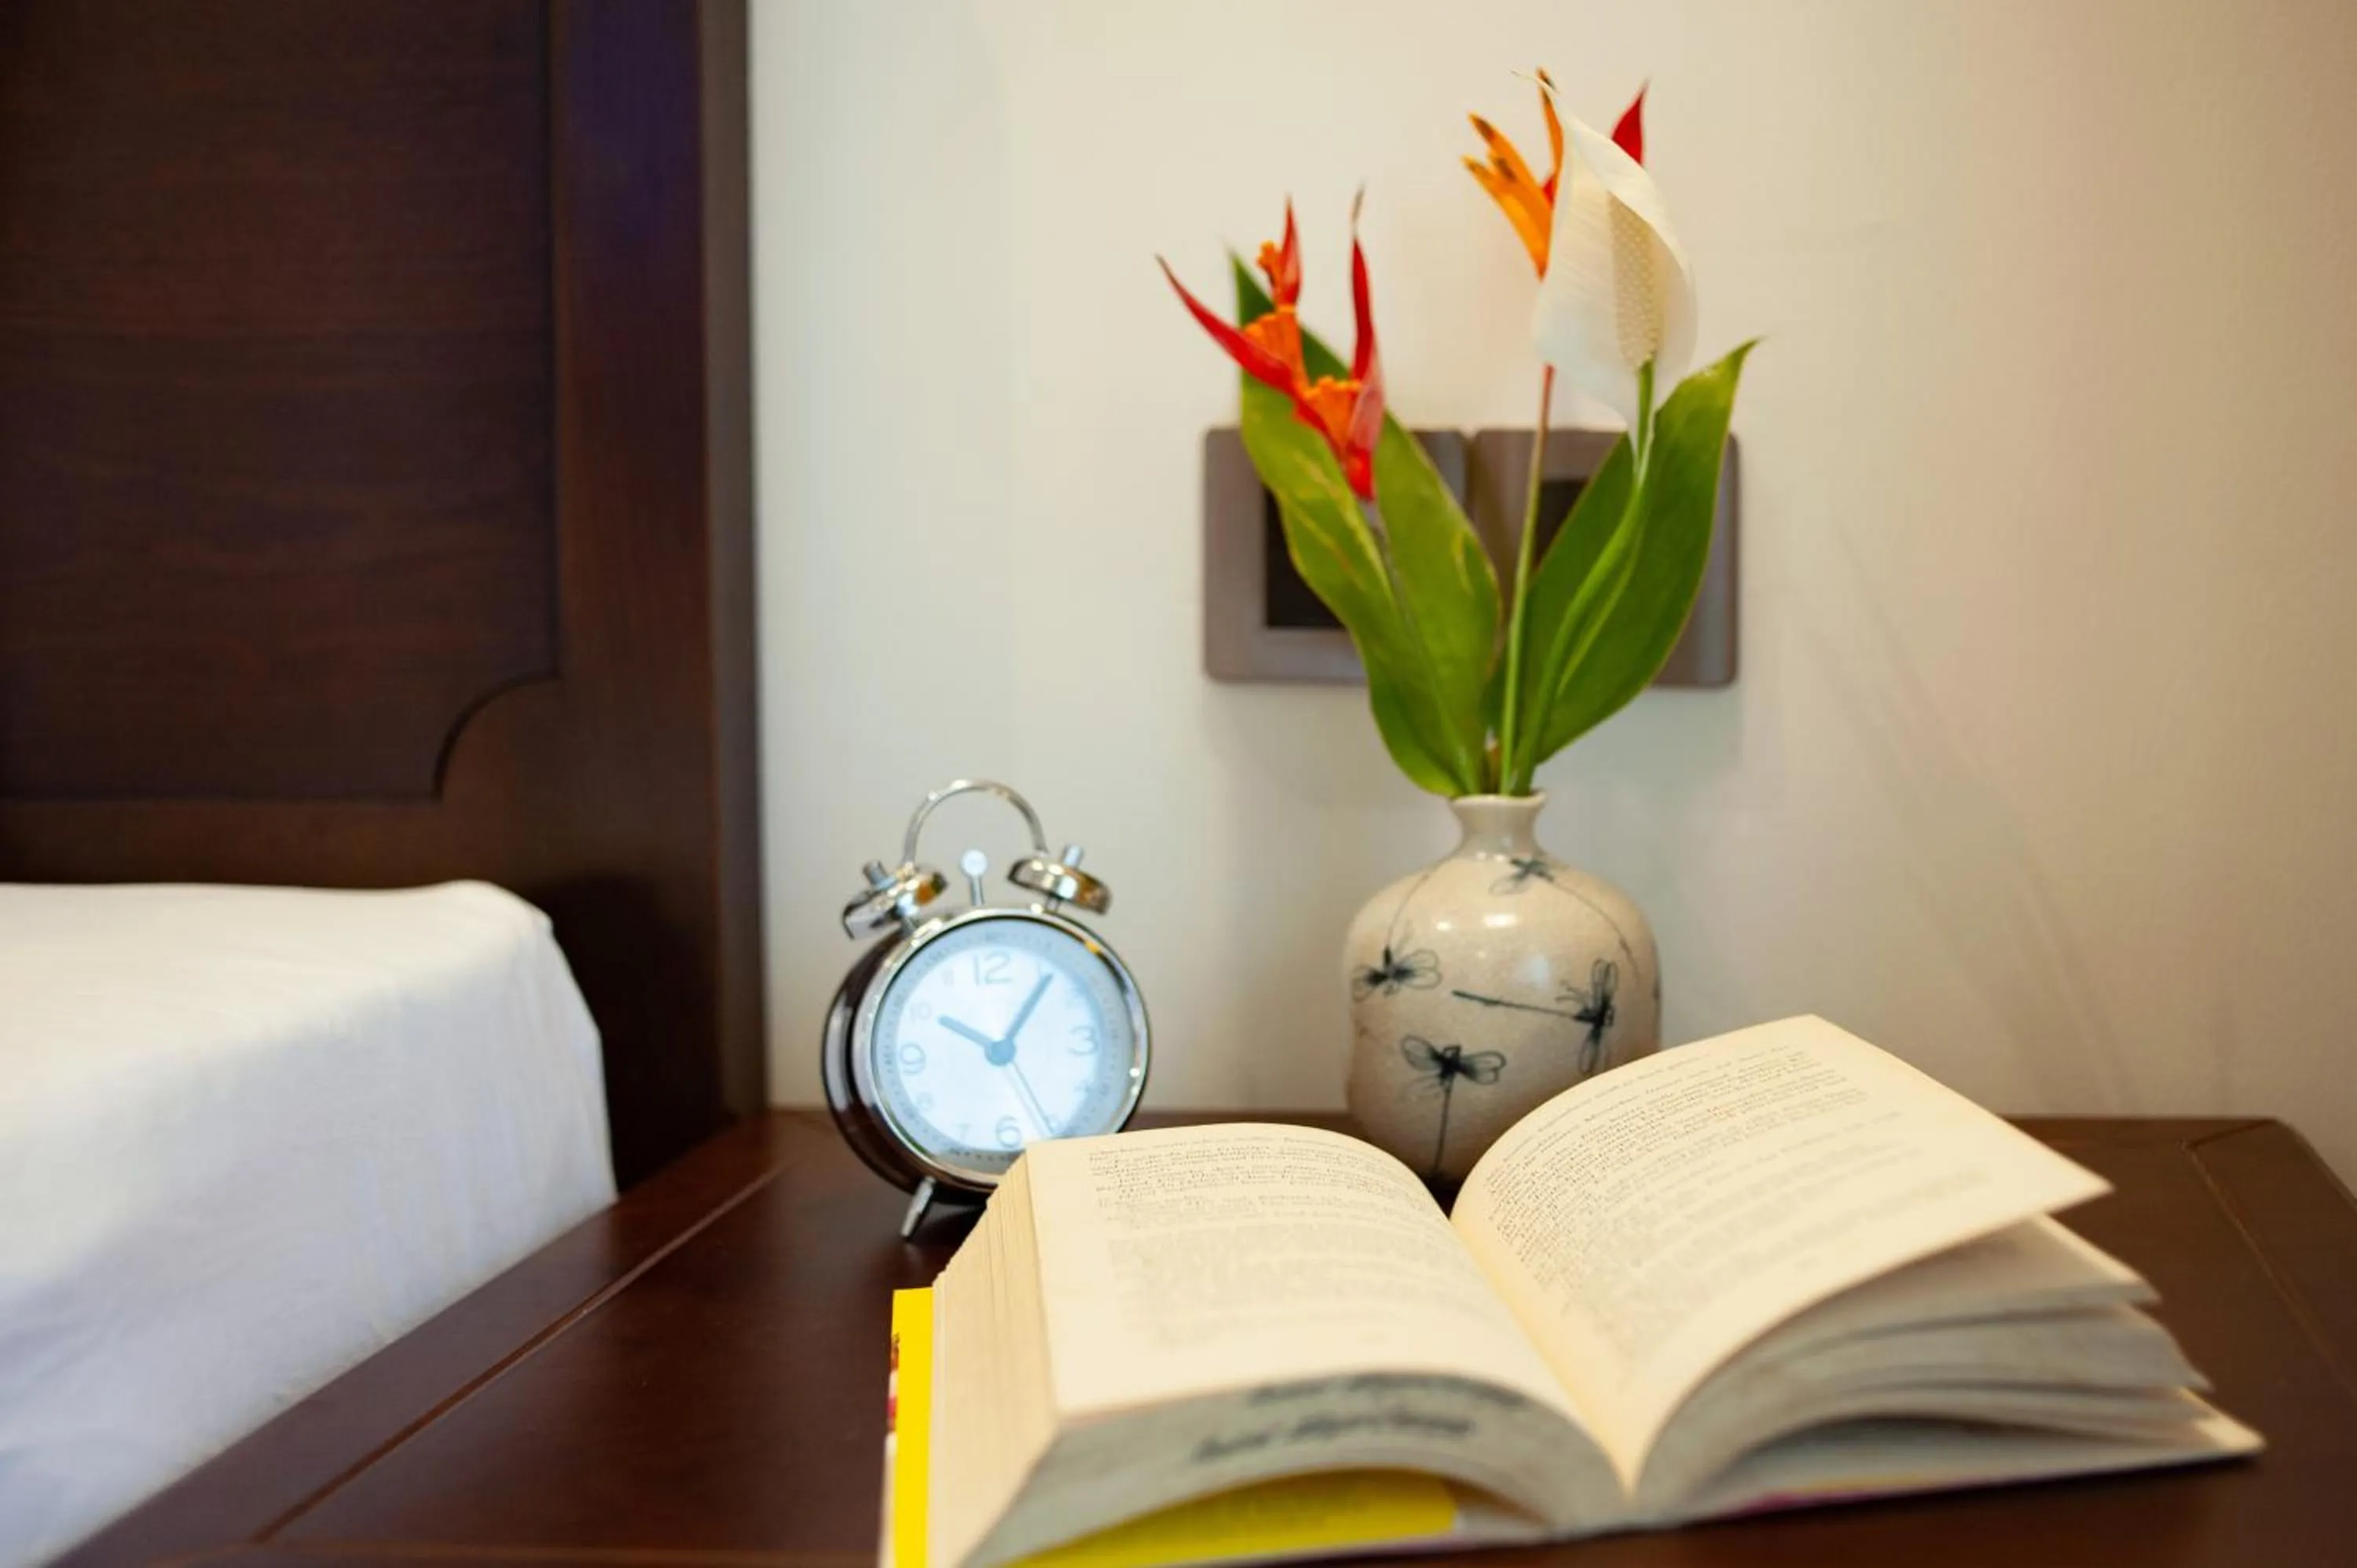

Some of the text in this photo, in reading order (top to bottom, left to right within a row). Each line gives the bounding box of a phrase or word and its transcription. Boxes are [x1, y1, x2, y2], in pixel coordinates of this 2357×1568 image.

[973, 950, 1013, 986] 12
[1066, 1025, 1099, 1057] 3
[900, 1042, 927, 1076] 9
[995, 1116, 1022, 1149] 6
